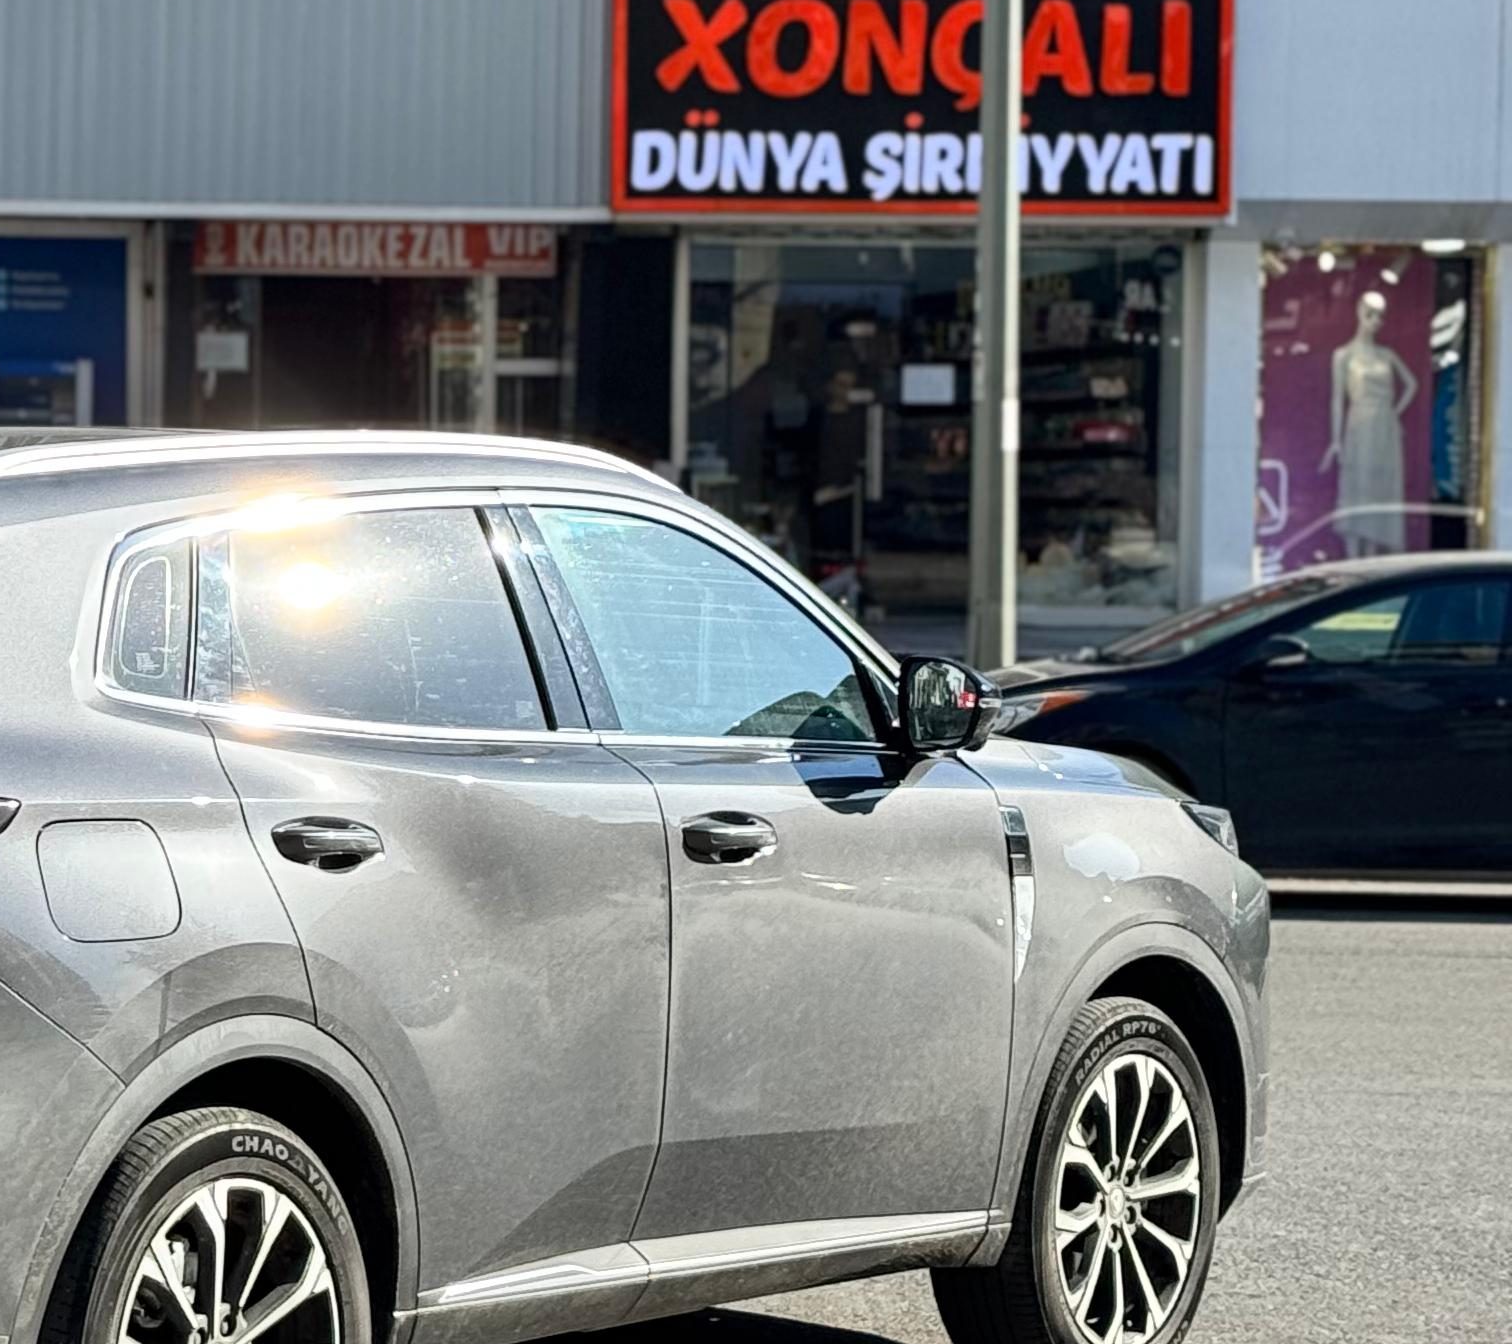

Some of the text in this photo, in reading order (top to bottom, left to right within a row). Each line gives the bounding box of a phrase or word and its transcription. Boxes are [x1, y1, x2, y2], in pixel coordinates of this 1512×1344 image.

[630, 109, 848, 193] DÜNYA
[489, 227, 553, 255] VIP
[1075, 1030, 1120, 1086] RADIAL
